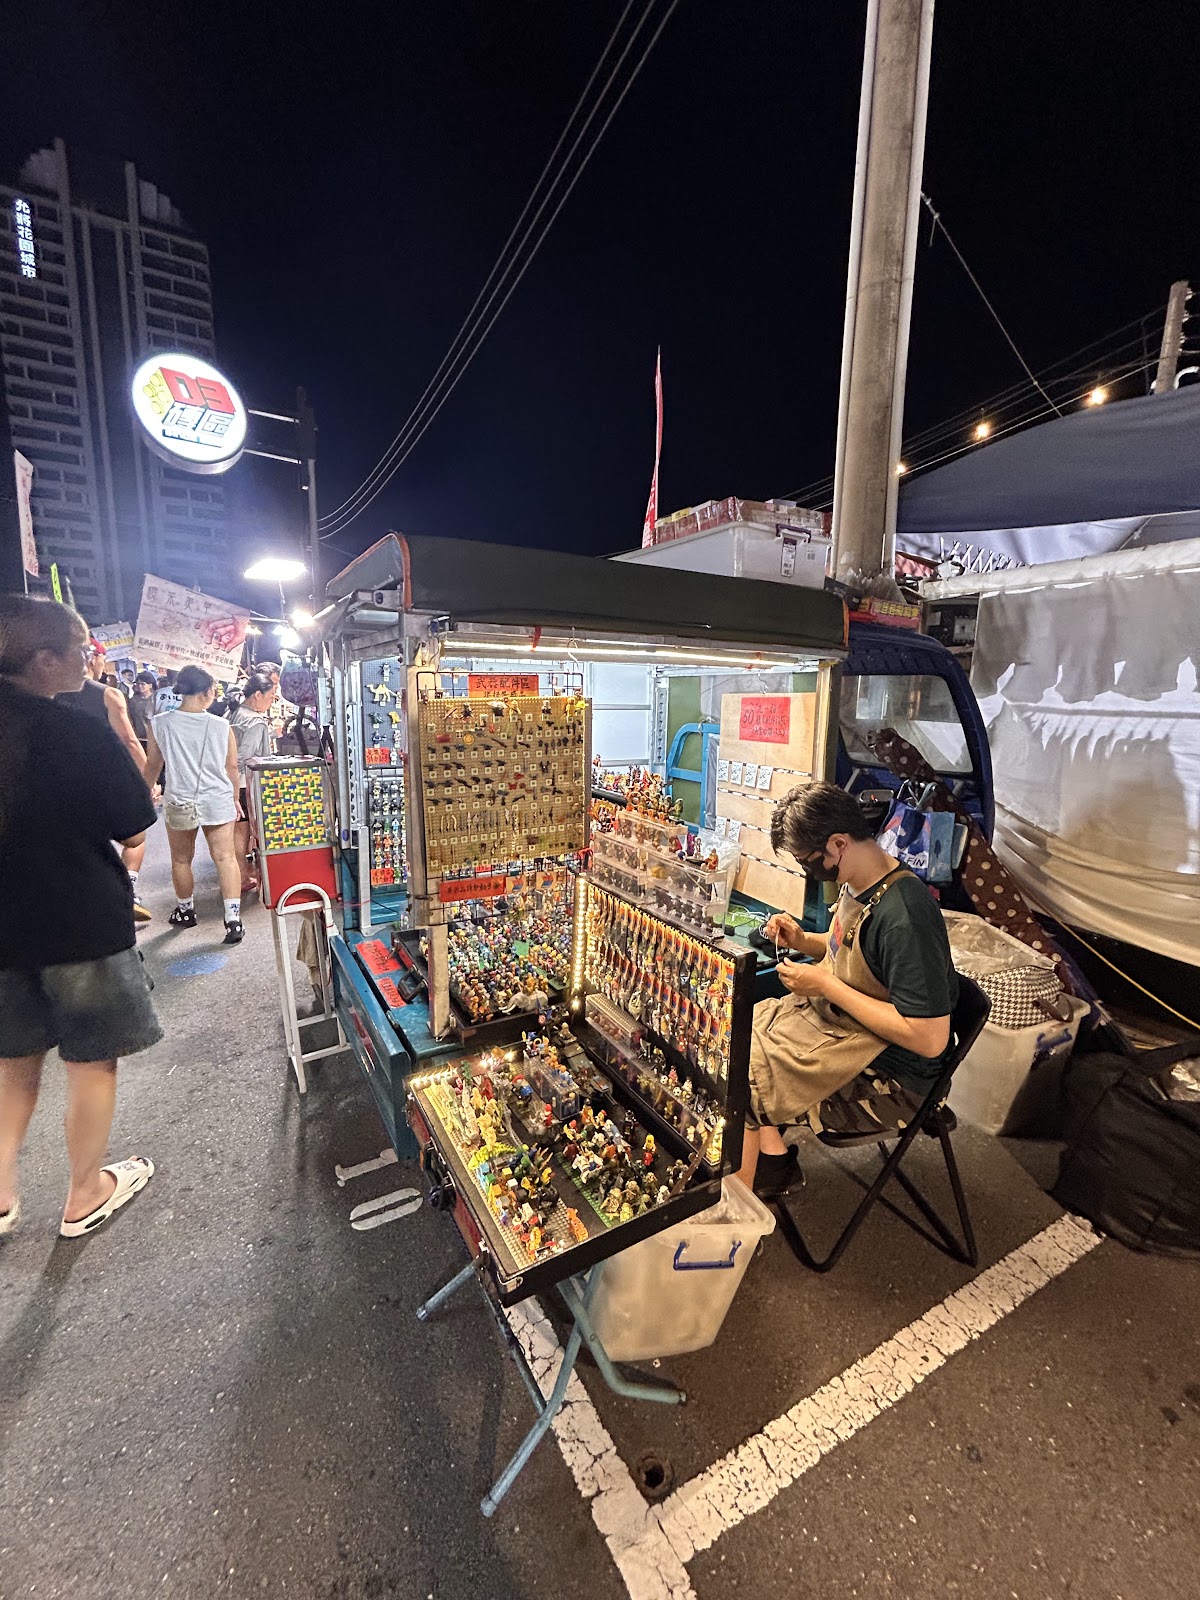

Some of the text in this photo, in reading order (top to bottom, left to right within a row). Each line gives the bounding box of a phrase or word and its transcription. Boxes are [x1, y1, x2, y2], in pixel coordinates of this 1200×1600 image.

[475, 676, 531, 690] 武器配件區
[742, 708, 755, 725] 50
[907, 857, 925, 867] FIN
